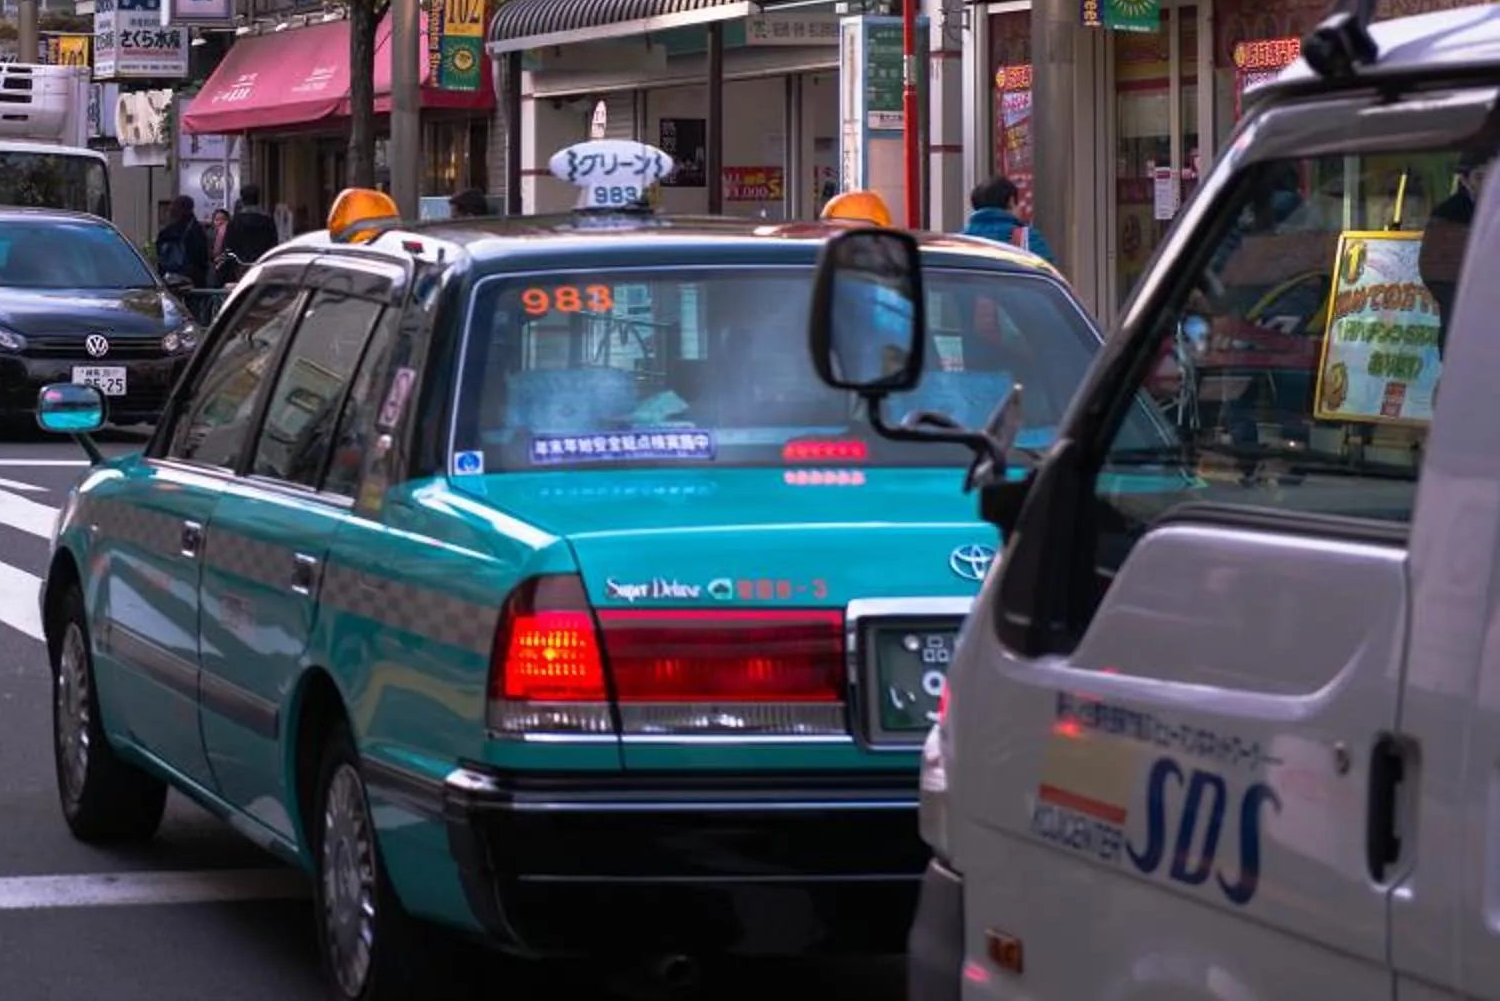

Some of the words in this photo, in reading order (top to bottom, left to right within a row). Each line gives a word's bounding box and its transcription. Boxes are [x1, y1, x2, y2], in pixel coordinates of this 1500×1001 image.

[578, 154, 651, 177] グリーン
[594, 186, 638, 203] 983
[521, 284, 613, 315] 983
[606, 577, 649, 603] Super
[653, 577, 701, 599] Deluxe
[1126, 757, 1283, 905] SDS
